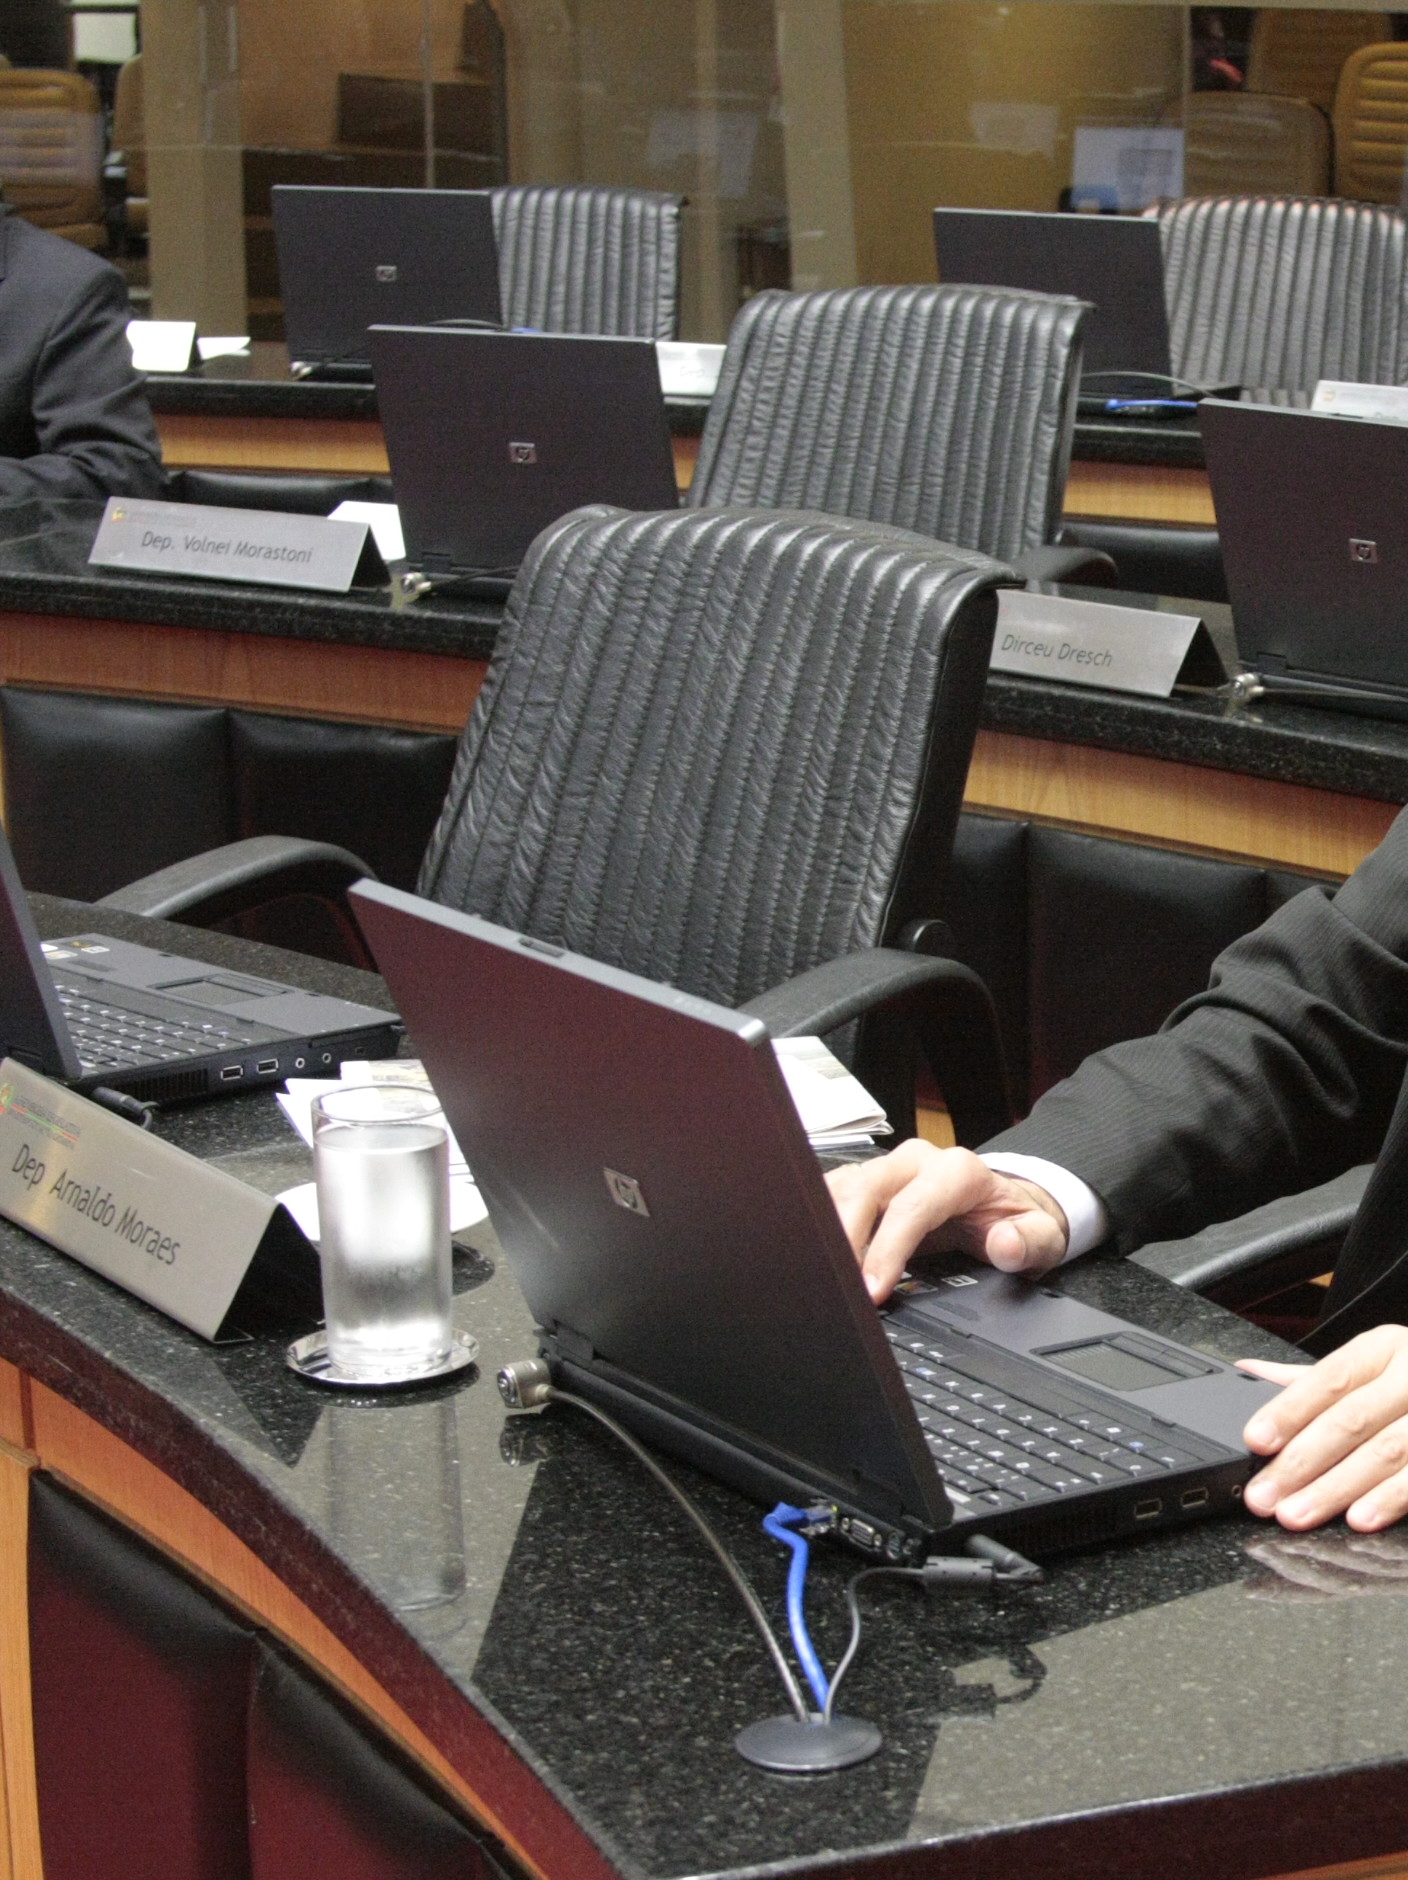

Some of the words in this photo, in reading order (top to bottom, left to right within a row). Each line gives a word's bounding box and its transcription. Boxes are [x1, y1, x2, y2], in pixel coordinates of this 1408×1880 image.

[140, 530, 175, 554] Dep.
[183, 535, 232, 555] Volnei
[233, 541, 314, 564] Morastoni
[1001, 633, 1054, 658] Dirceu
[1057, 643, 1113, 668] Dresch
[49, 1168, 116, 1228] Arnaldo
[114, 1206, 181, 1266] Moraes
